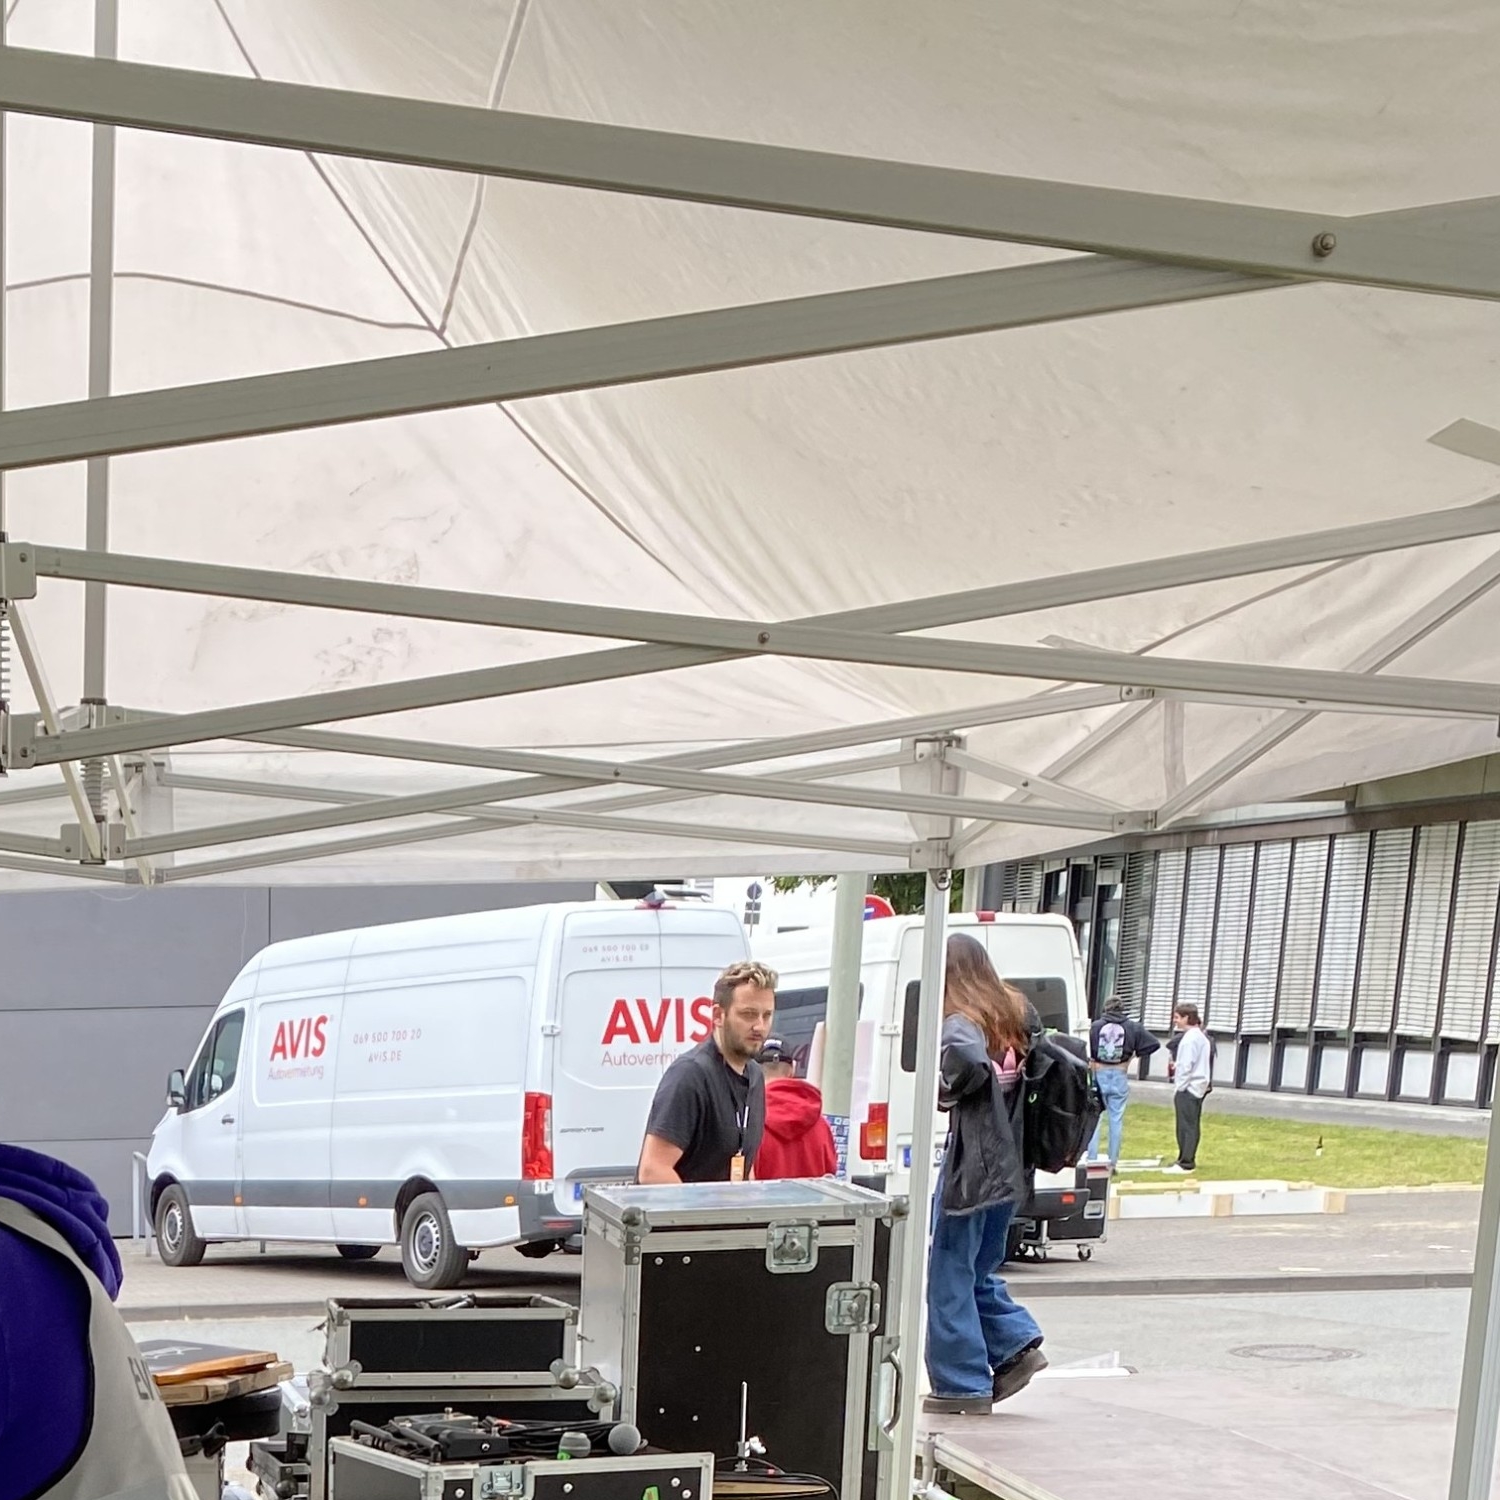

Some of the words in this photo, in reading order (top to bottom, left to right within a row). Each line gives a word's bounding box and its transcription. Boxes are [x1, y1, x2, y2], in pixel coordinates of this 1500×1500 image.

[353, 1033, 369, 1045] 069
[372, 1031, 388, 1043] 500
[391, 1030, 407, 1041] 700
[411, 1028, 422, 1040] 20
[601, 997, 714, 1044] AVIS
[270, 1014, 329, 1062] AVIS
[267, 1064, 325, 1081] Autovermietung
